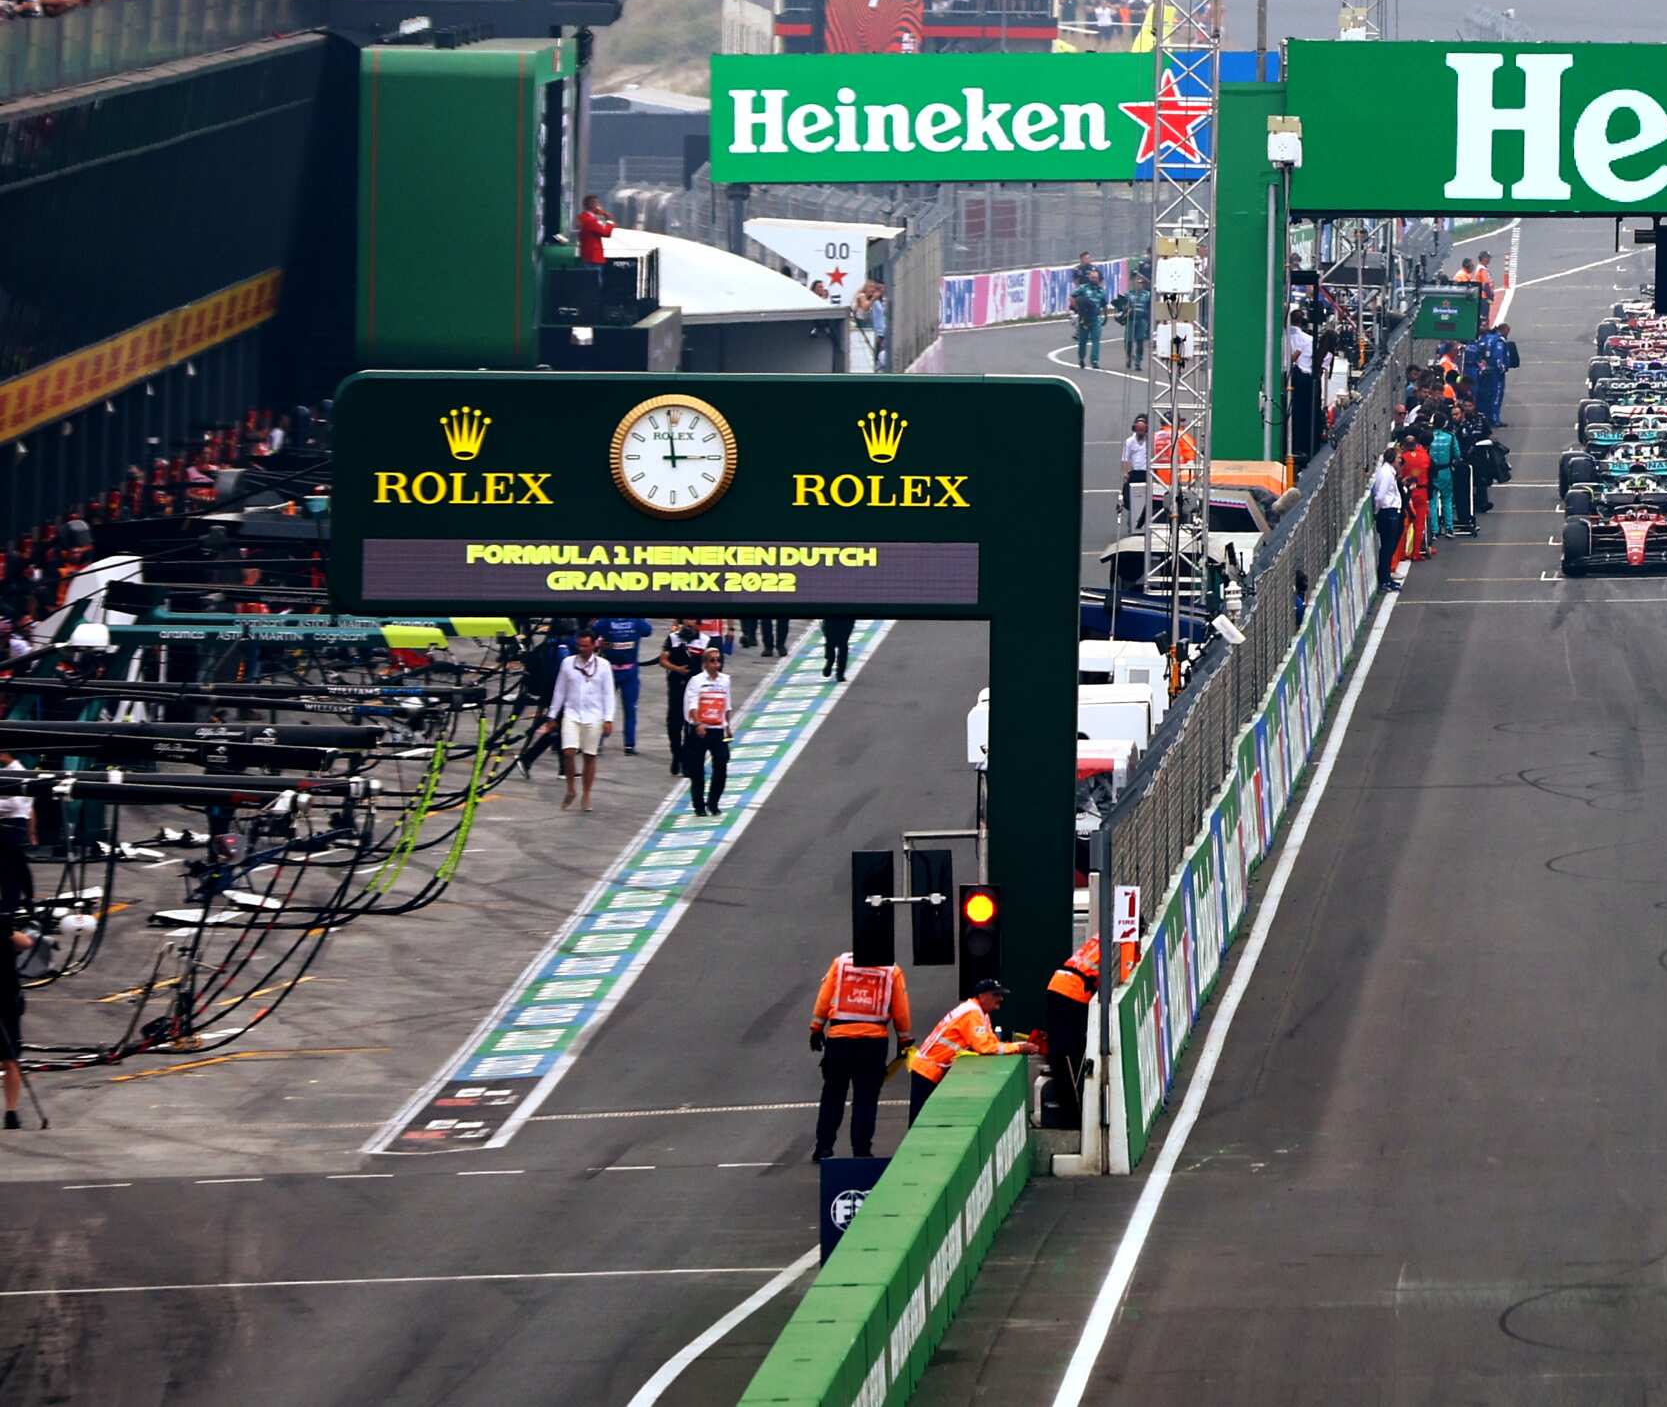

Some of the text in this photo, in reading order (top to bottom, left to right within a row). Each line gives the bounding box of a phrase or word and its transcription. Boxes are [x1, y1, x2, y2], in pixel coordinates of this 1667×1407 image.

[728, 87, 1111, 154] Heineken
[653, 432, 694, 441] ROLEX
[373, 471, 554, 505] ROLEX
[792, 474, 971, 507] ROLEX
[466, 544, 878, 567] FORMULA 1 HEINEKEN DUTCH
[546, 571, 797, 592] GRAND PRIX 2022
[216, 631, 256, 641] ASTN
